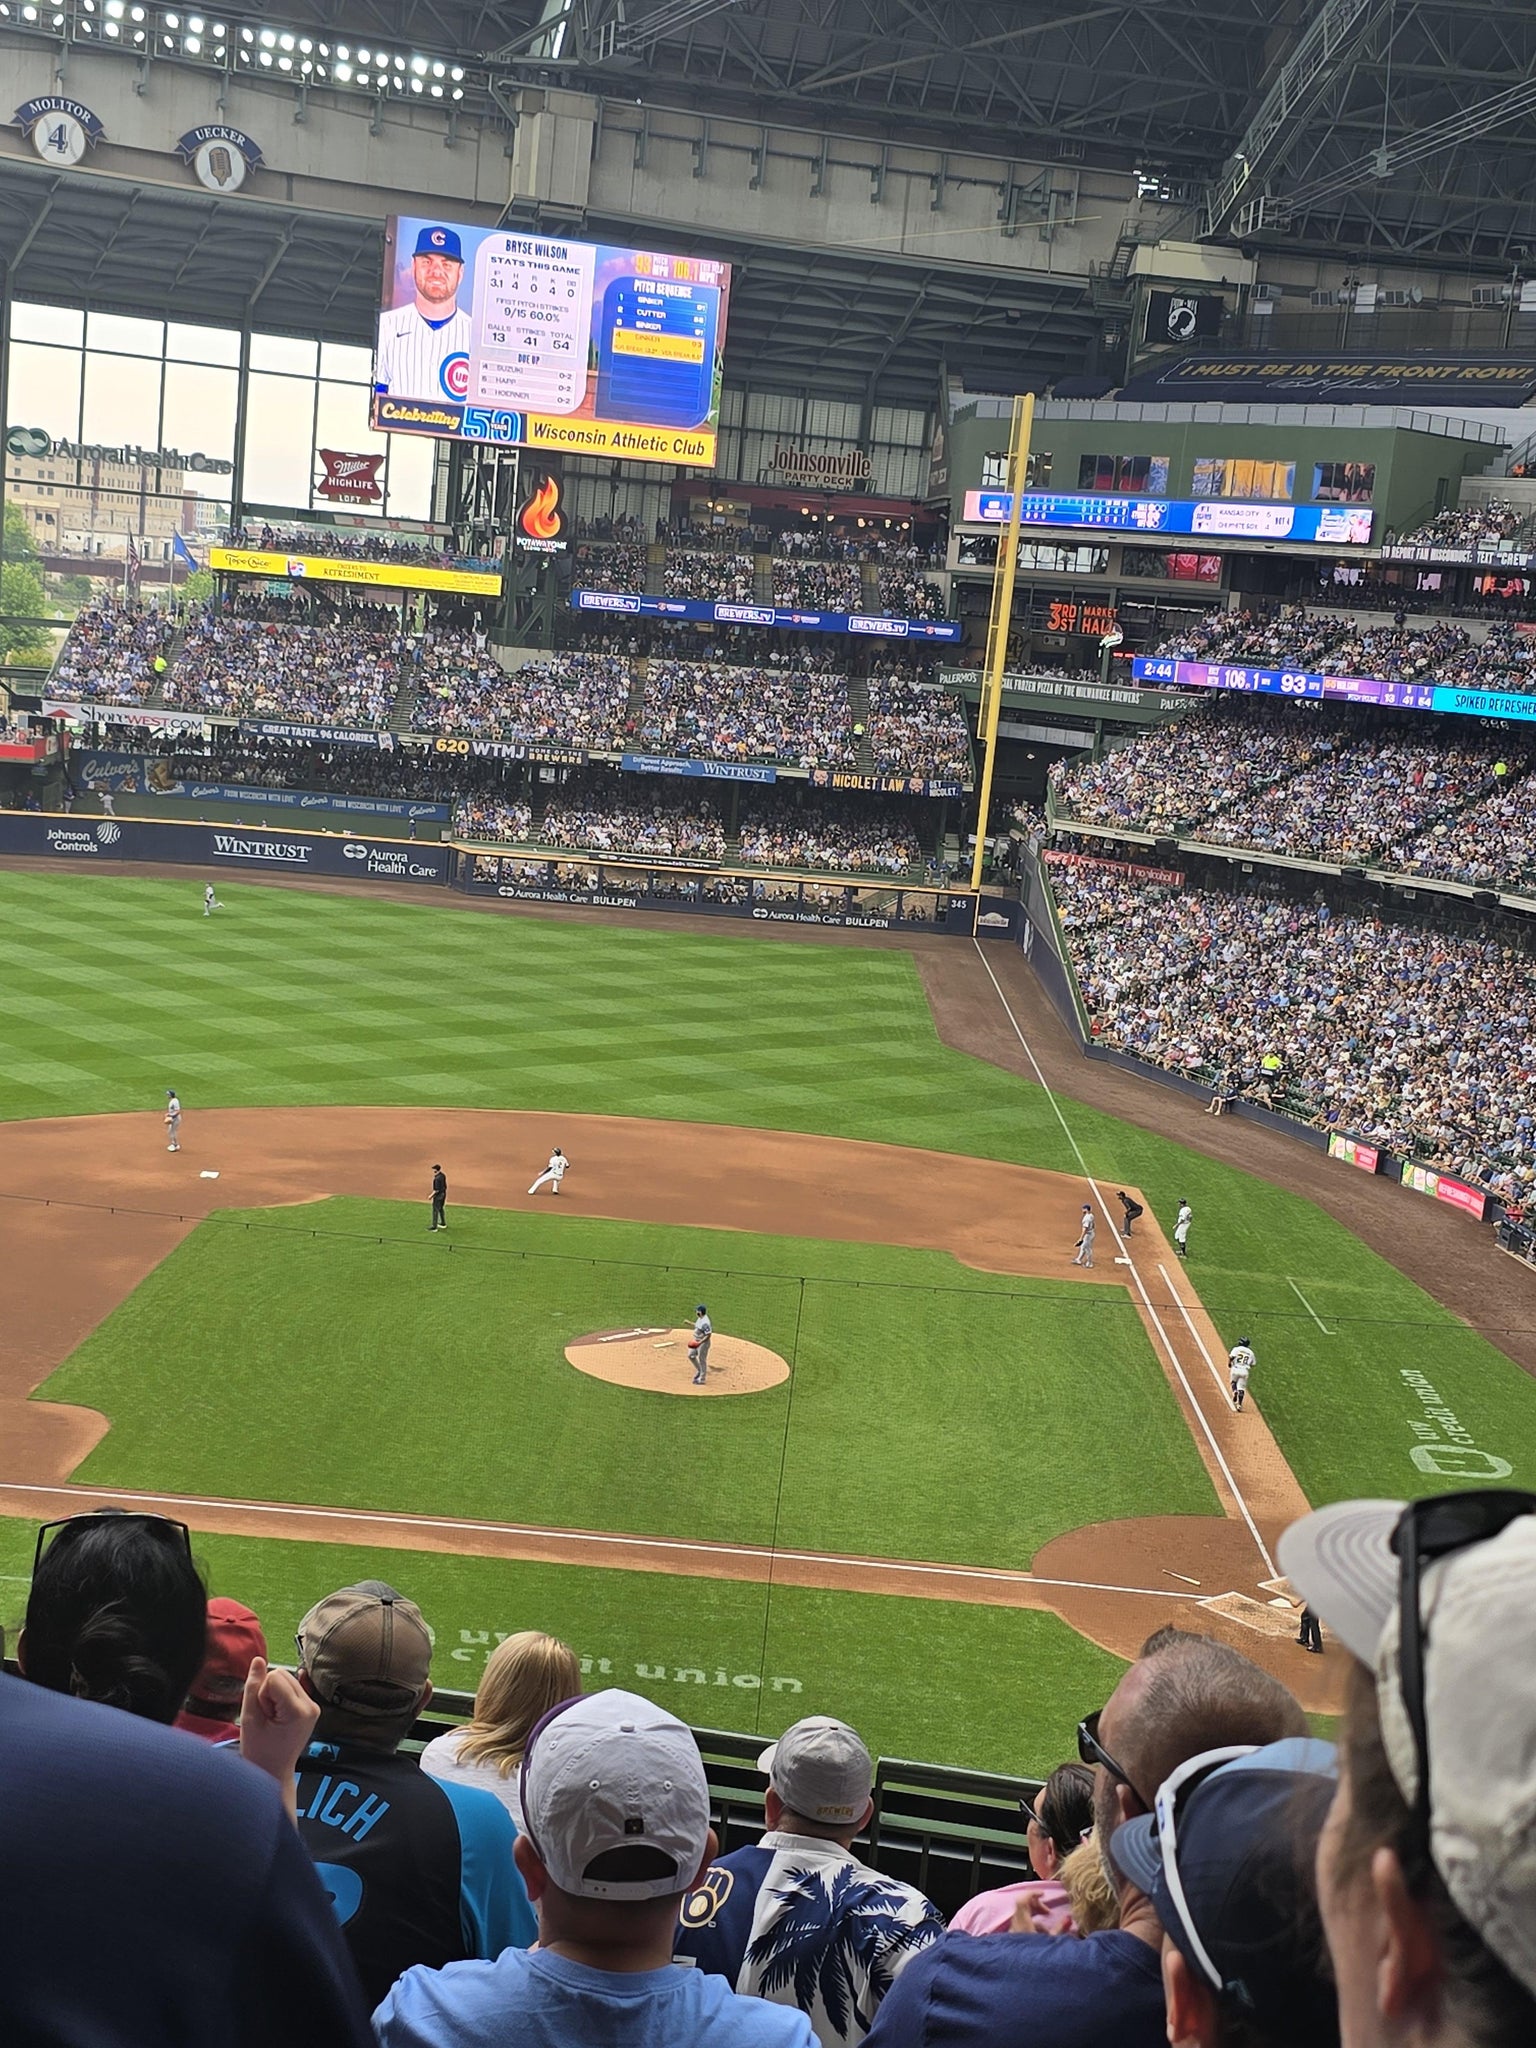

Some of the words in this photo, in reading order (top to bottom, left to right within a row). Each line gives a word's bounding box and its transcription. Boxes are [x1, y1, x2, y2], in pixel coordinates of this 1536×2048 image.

[29, 98, 91, 123] MOLITOR
[48, 124, 68, 154] 4
[195, 127, 246, 147] UECKER
[505, 239, 533, 255] BRYSE
[535, 243, 568, 260] WILSON
[491, 257, 525, 267] STATS
[528, 260, 550, 270] THIS
[552, 265, 581, 275] GAME
[490, 278, 503, 288] 3.1
[512, 281, 518, 290] 4
[530, 284, 537, 293] 0
[549, 287, 556, 295] 4
[567, 289, 575, 298] 0
[504, 307, 526, 319] 9/15
[530, 311, 560, 322] 60.0%
[492, 332, 505, 342] 13
[523, 336, 537, 347] 41
[552, 340, 570, 351] 54
[550, 331, 574, 341] TOTAL
[1192, 364, 1258, 377] MUST
[1256, 365, 1288, 377] BE
[1290, 365, 1315, 377] IN
[1323, 365, 1370, 377] THE
[1370, 365, 1454, 379] FRONT
[1456, 367, 1534, 380] ROW!
[381, 402, 461, 431] Celebrating
[462, 406, 522, 442] 50
[532, 422, 607, 447] Wisconsin
[610, 431, 669, 453] Athletic
[672, 439, 706, 458] Club
[56, 437, 121, 464] Aurora
[124, 444, 184, 470] Health
[190, 452, 234, 476] Care
[768, 443, 872, 478] Johnsonville
[333, 460, 370, 477] Miller
[328, 477, 352, 488] HIGH
[353, 480, 373, 490] LIFE
[785, 471, 821, 482] PARTY
[823, 475, 853, 487] DECK
[339, 494, 361, 503] LOFT
[1416, 547, 1429, 561] FAN
[1476, 551, 1493, 564] TEXT
[322, 568, 380, 581] REFRESHMENT
[1083, 606, 1119, 618] MARKET
[1144, 662, 1172, 678] 2:44
[1280, 674, 1307, 694] 93
[1402, 695, 1414, 705] 41
[1455, 694, 1486, 710] SPIKED
[262, 724, 290, 735] GREAT
[291, 726, 319, 739] TASTE.
[320, 730, 332, 739] 96
[333, 732, 377, 744] CALORIES.
[435, 738, 470, 755] 620
[471, 741, 526, 760] WTMJ
[528, 753, 582, 765] BREWERS
[82, 759, 140, 782] Culver's
[703, 762, 768, 780] WINTRUST
[832, 773, 878, 790] NICOLET
[880, 777, 906, 793] LAW
[47, 829, 90, 842] Johnson
[54, 841, 98, 853] Controls
[213, 835, 308, 859] WINTRUST
[368, 849, 408, 863] Aurora
[367, 860, 406, 875] Health
[409, 864, 438, 877] Care
[515, 889, 541, 900] Aurora
[542, 891, 568, 902] Health
[569, 893, 588, 904] Care
[592, 896, 637, 908] BULLPEN
[951, 899, 967, 909] 345
[768, 911, 795, 922] Aurora
[796, 912, 821, 924] Health
[822, 915, 841, 926] Care
[845, 917, 889, 929] BULLPEN
[634, 1662, 804, 1693] union
